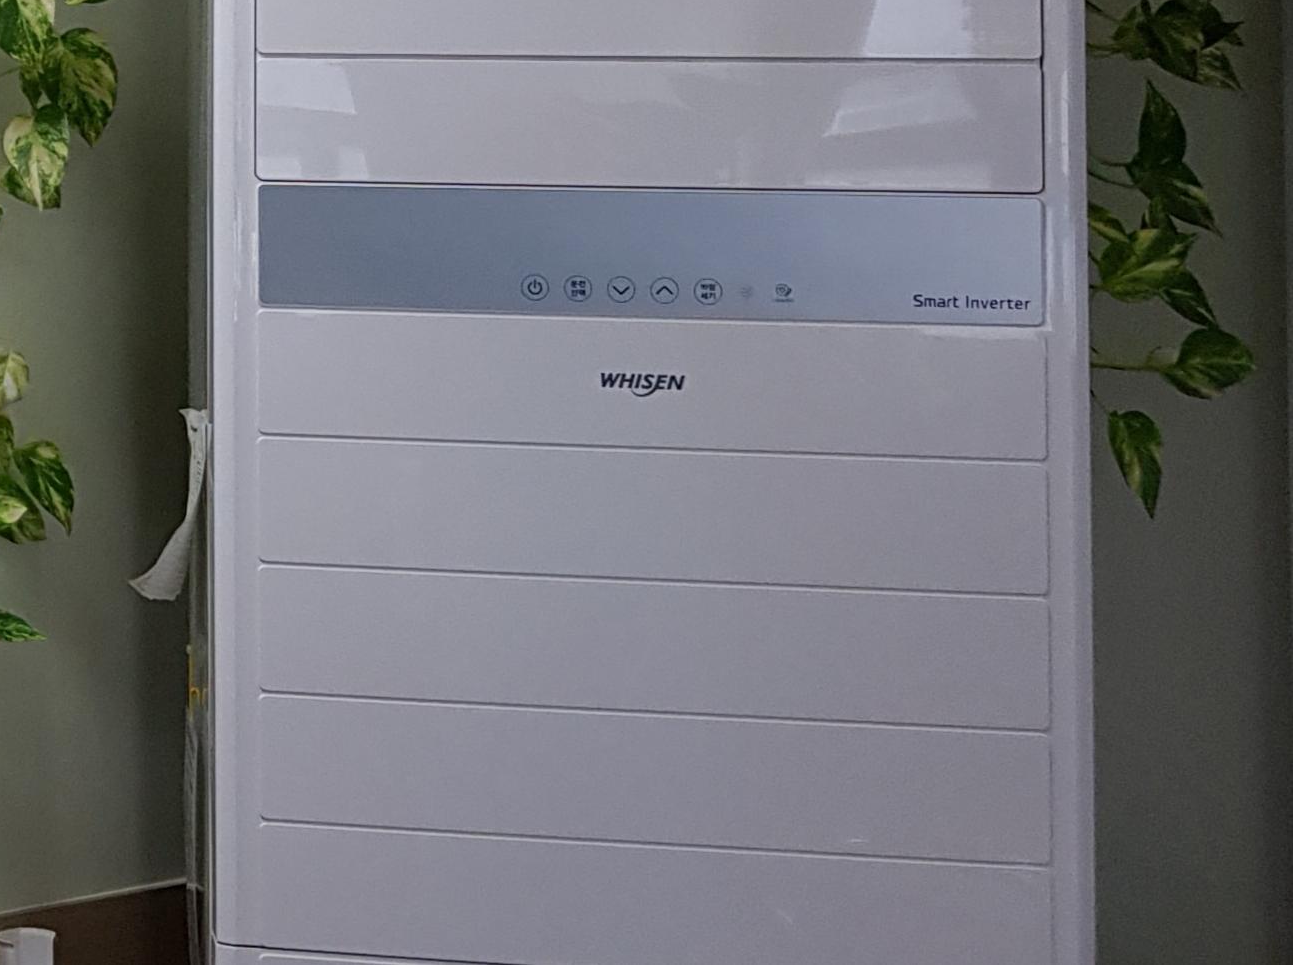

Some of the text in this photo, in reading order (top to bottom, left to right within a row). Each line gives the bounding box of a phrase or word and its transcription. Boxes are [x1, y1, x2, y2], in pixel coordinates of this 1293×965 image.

[913, 294, 1031, 310] Smart Inverter
[600, 372, 685, 395] WHISEN
